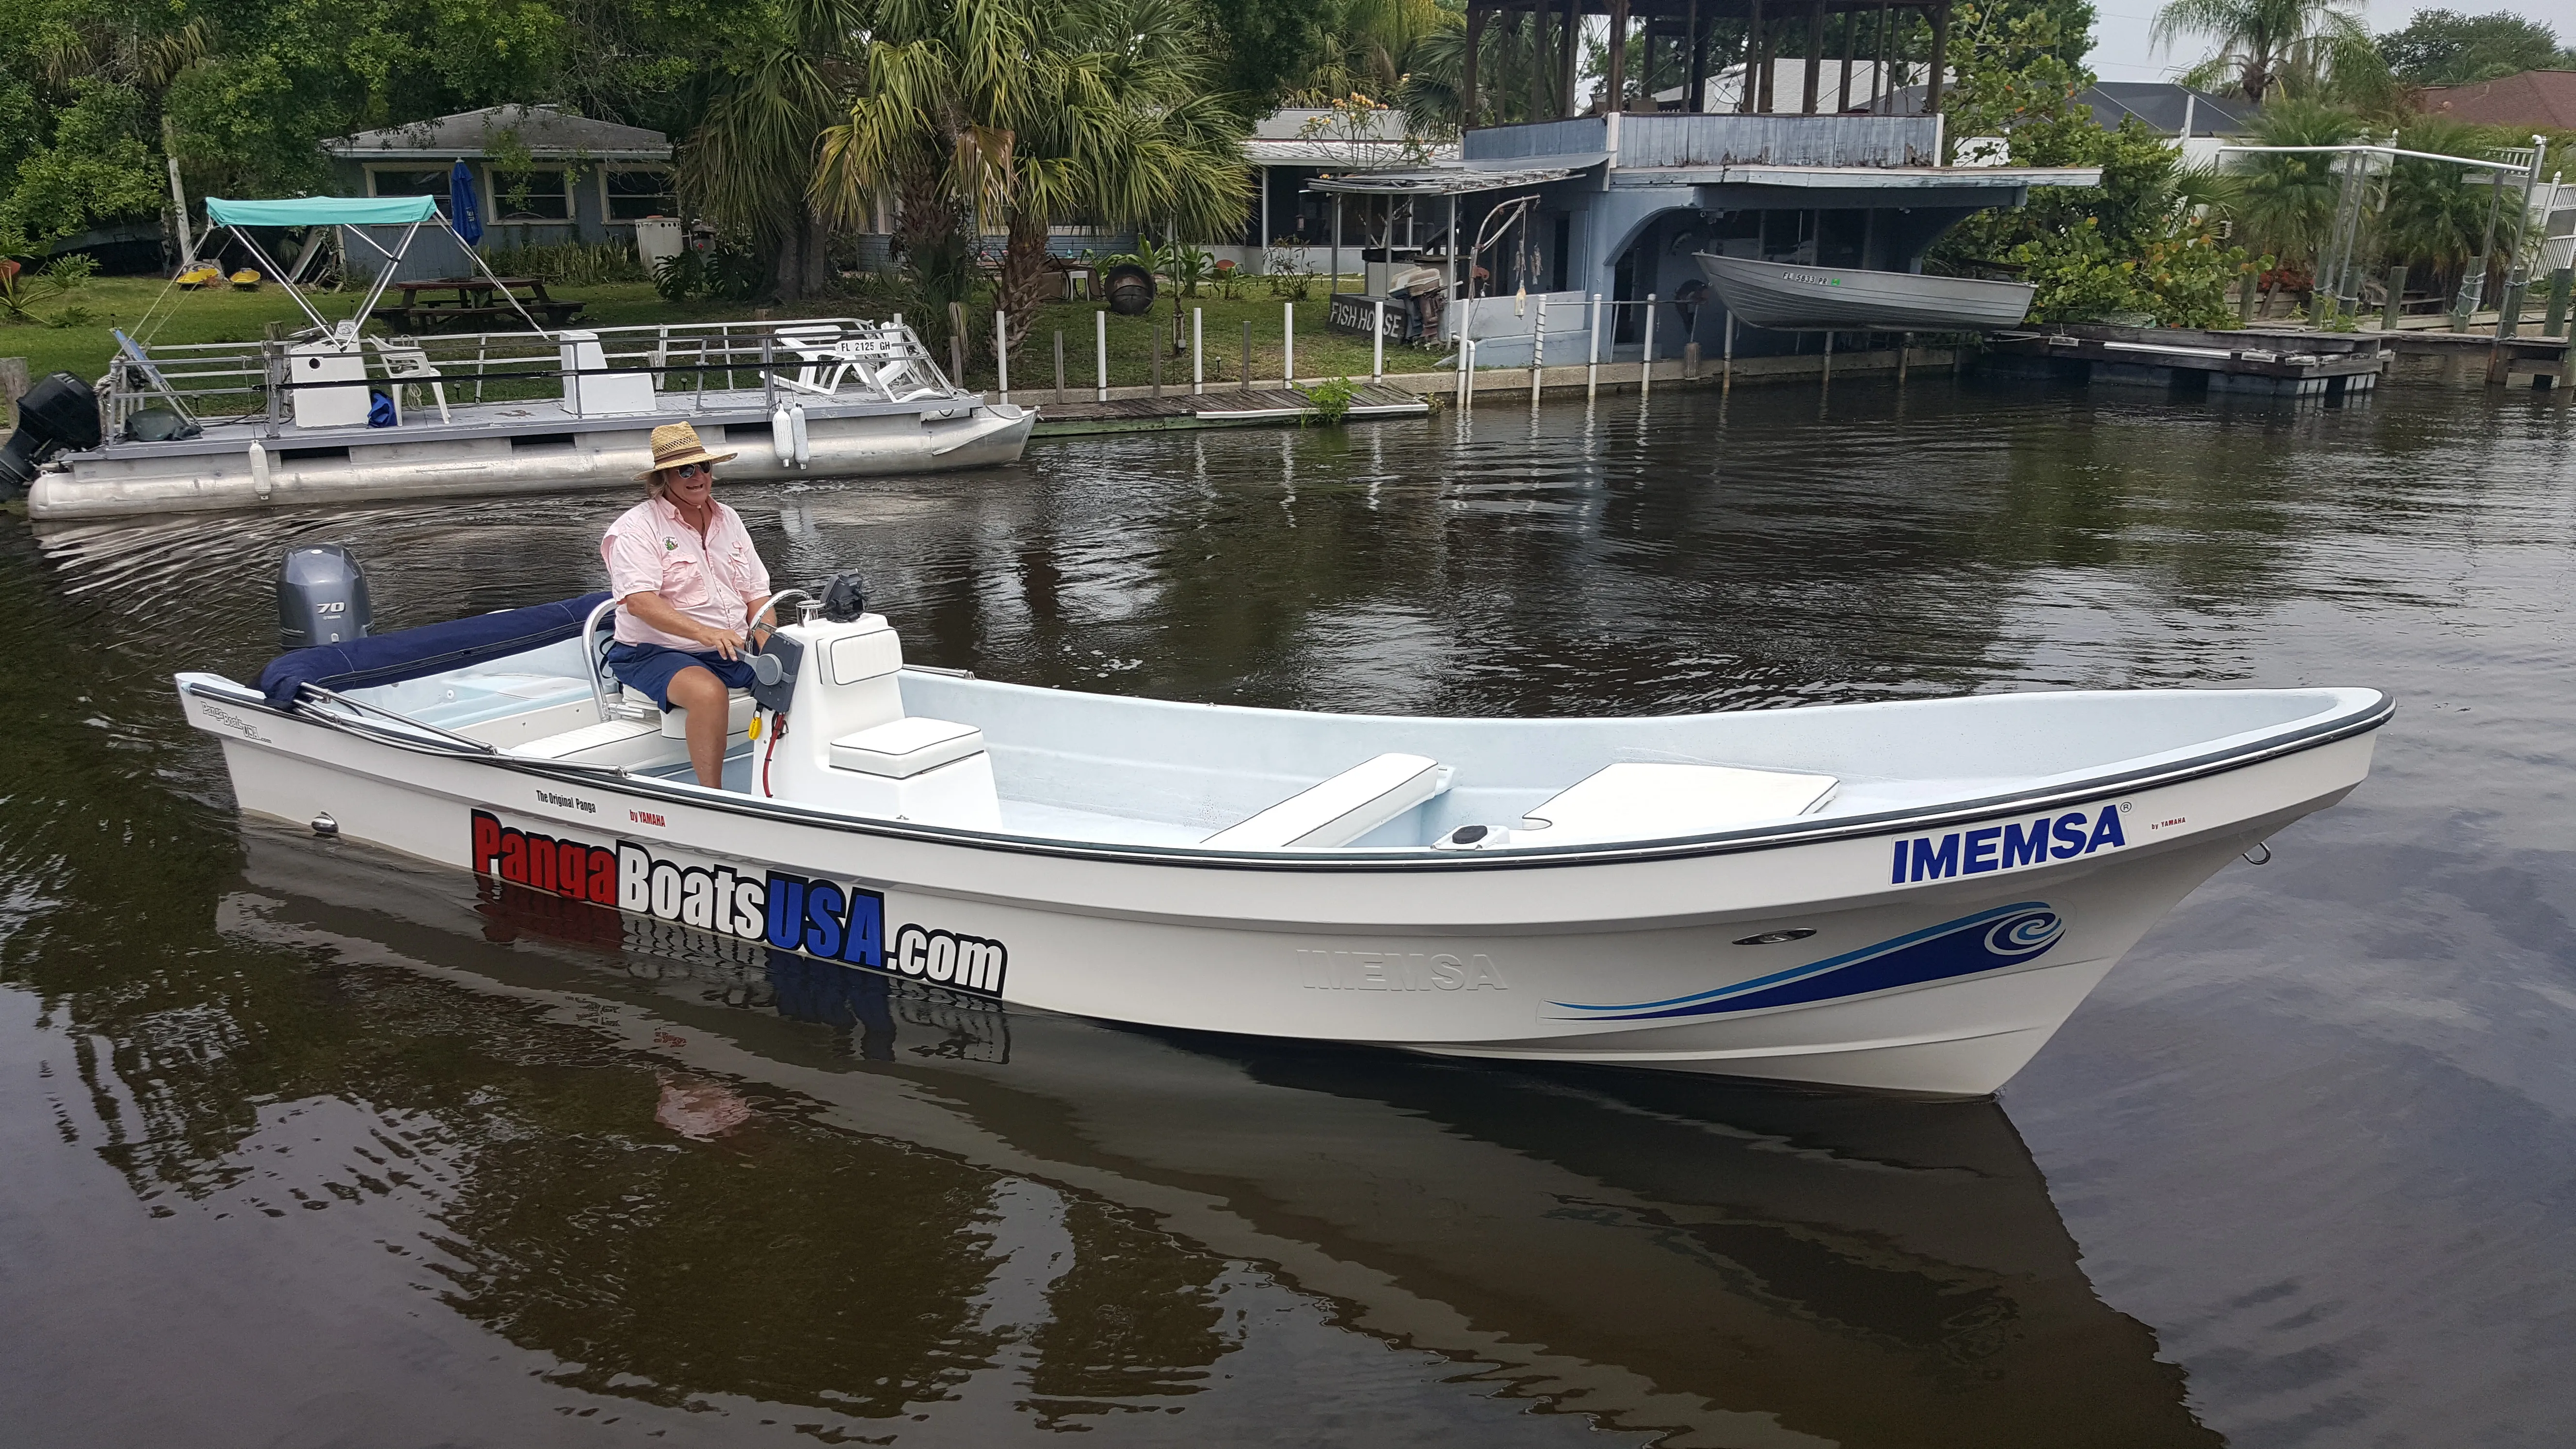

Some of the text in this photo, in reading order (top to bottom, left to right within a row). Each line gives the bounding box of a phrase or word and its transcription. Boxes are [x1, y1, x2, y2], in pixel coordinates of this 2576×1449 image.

[1796, 274, 1815, 283] 5833
[1330, 301, 1402, 338] FISH HOSE
[841, 341, 890, 352] FL 2125 GH
[317, 602, 346, 613] 70
[536, 789, 596, 813] The Original Panga
[629, 809, 666, 827] by YAMAHA
[2161, 817, 2186, 827] YAMAHA
[471, 808, 1008, 998] PangaBoatsUSA.com
[1296, 949, 1509, 991] IMEMSA
